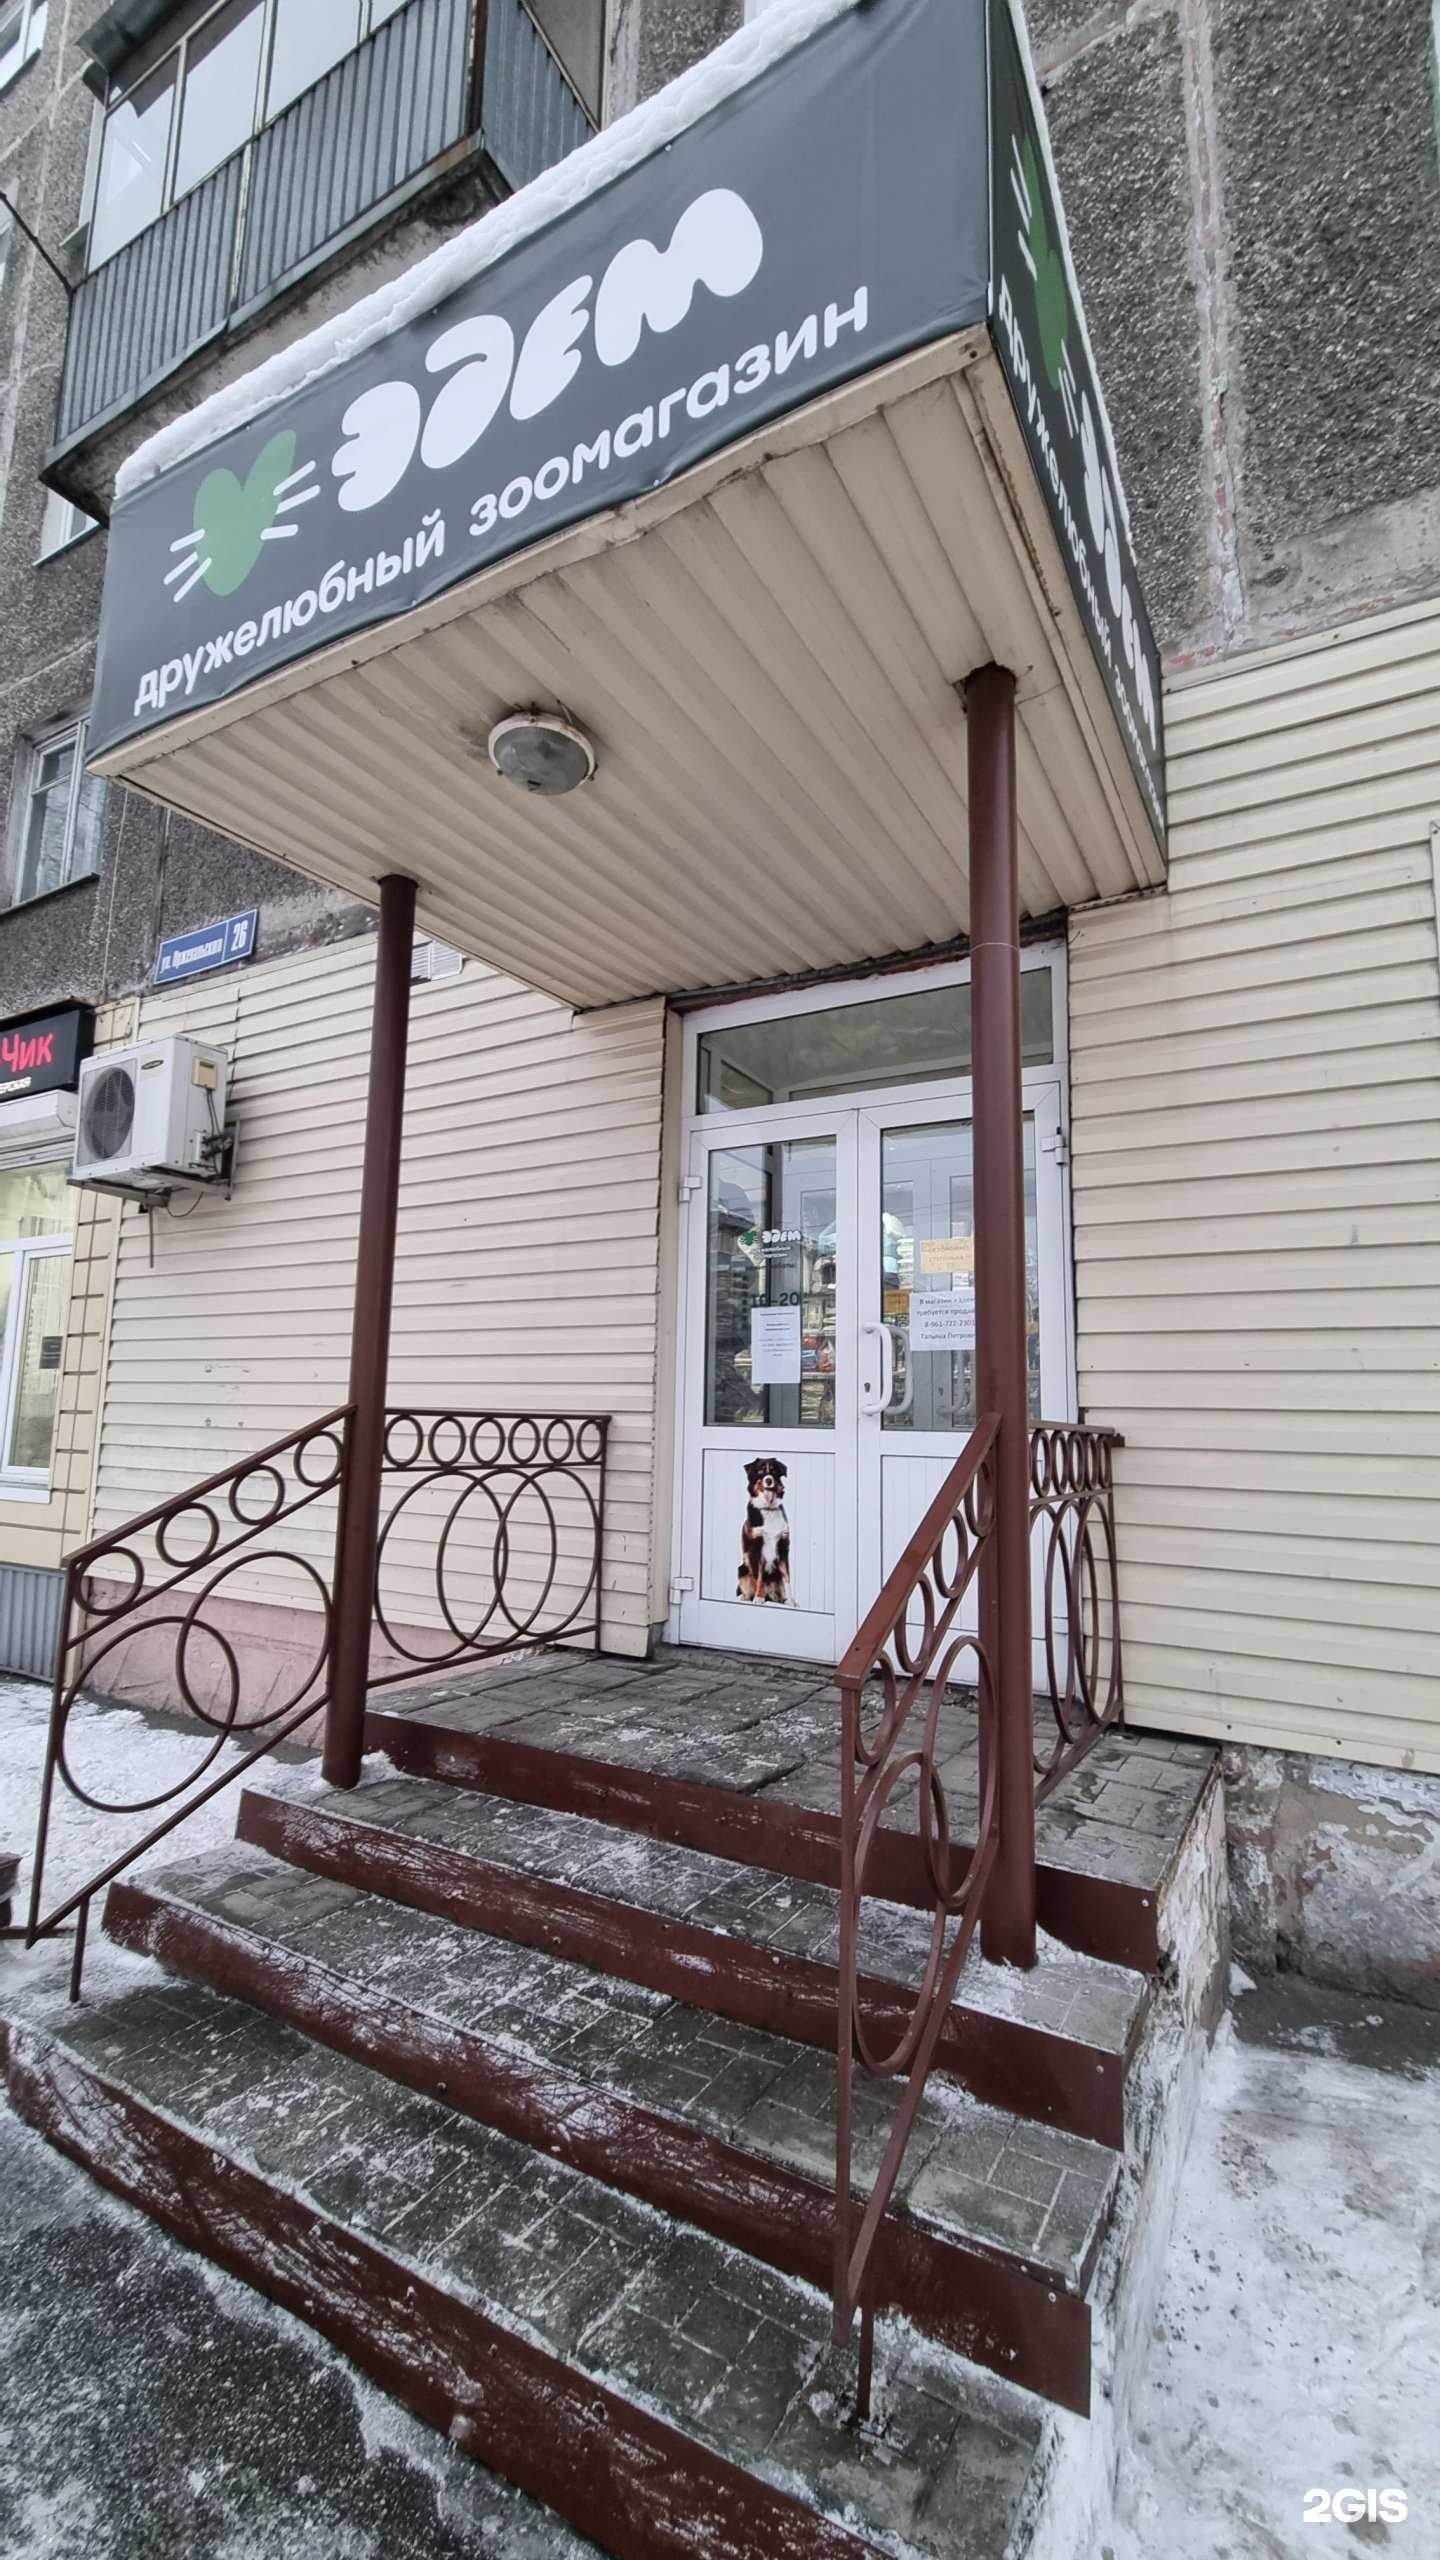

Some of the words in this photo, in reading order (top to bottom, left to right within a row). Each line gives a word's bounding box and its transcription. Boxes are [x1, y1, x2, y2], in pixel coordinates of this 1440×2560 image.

[133, 509, 445, 715] дружелюбный
[468, 286, 868, 536] зоомагазин
[230, 920, 249, 952] 26
[0, 1032, 54, 1073] ЧИК
